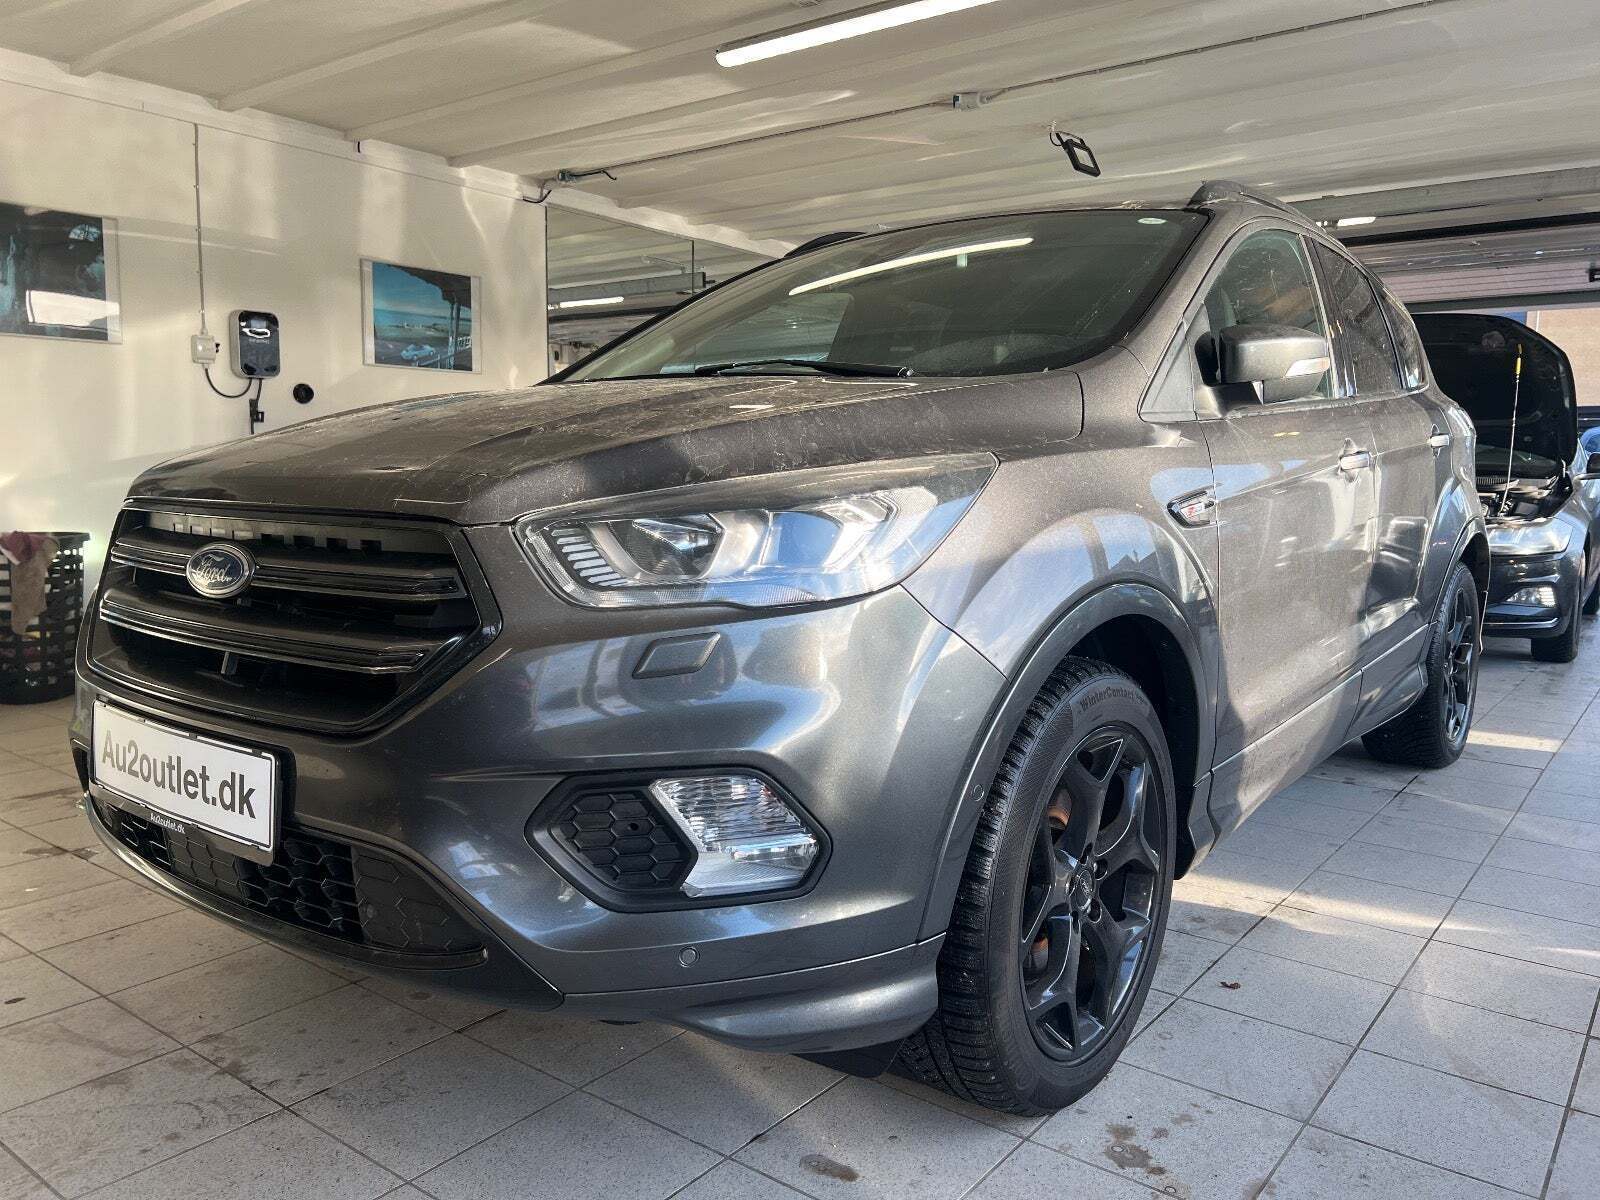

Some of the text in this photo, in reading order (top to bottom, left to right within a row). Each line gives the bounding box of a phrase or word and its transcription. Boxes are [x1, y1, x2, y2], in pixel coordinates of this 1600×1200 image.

[192, 554, 232, 586] Ford
[102, 729, 256, 819] Au2outlet.dk
[150, 812, 185, 834] Au2outlet.dk
